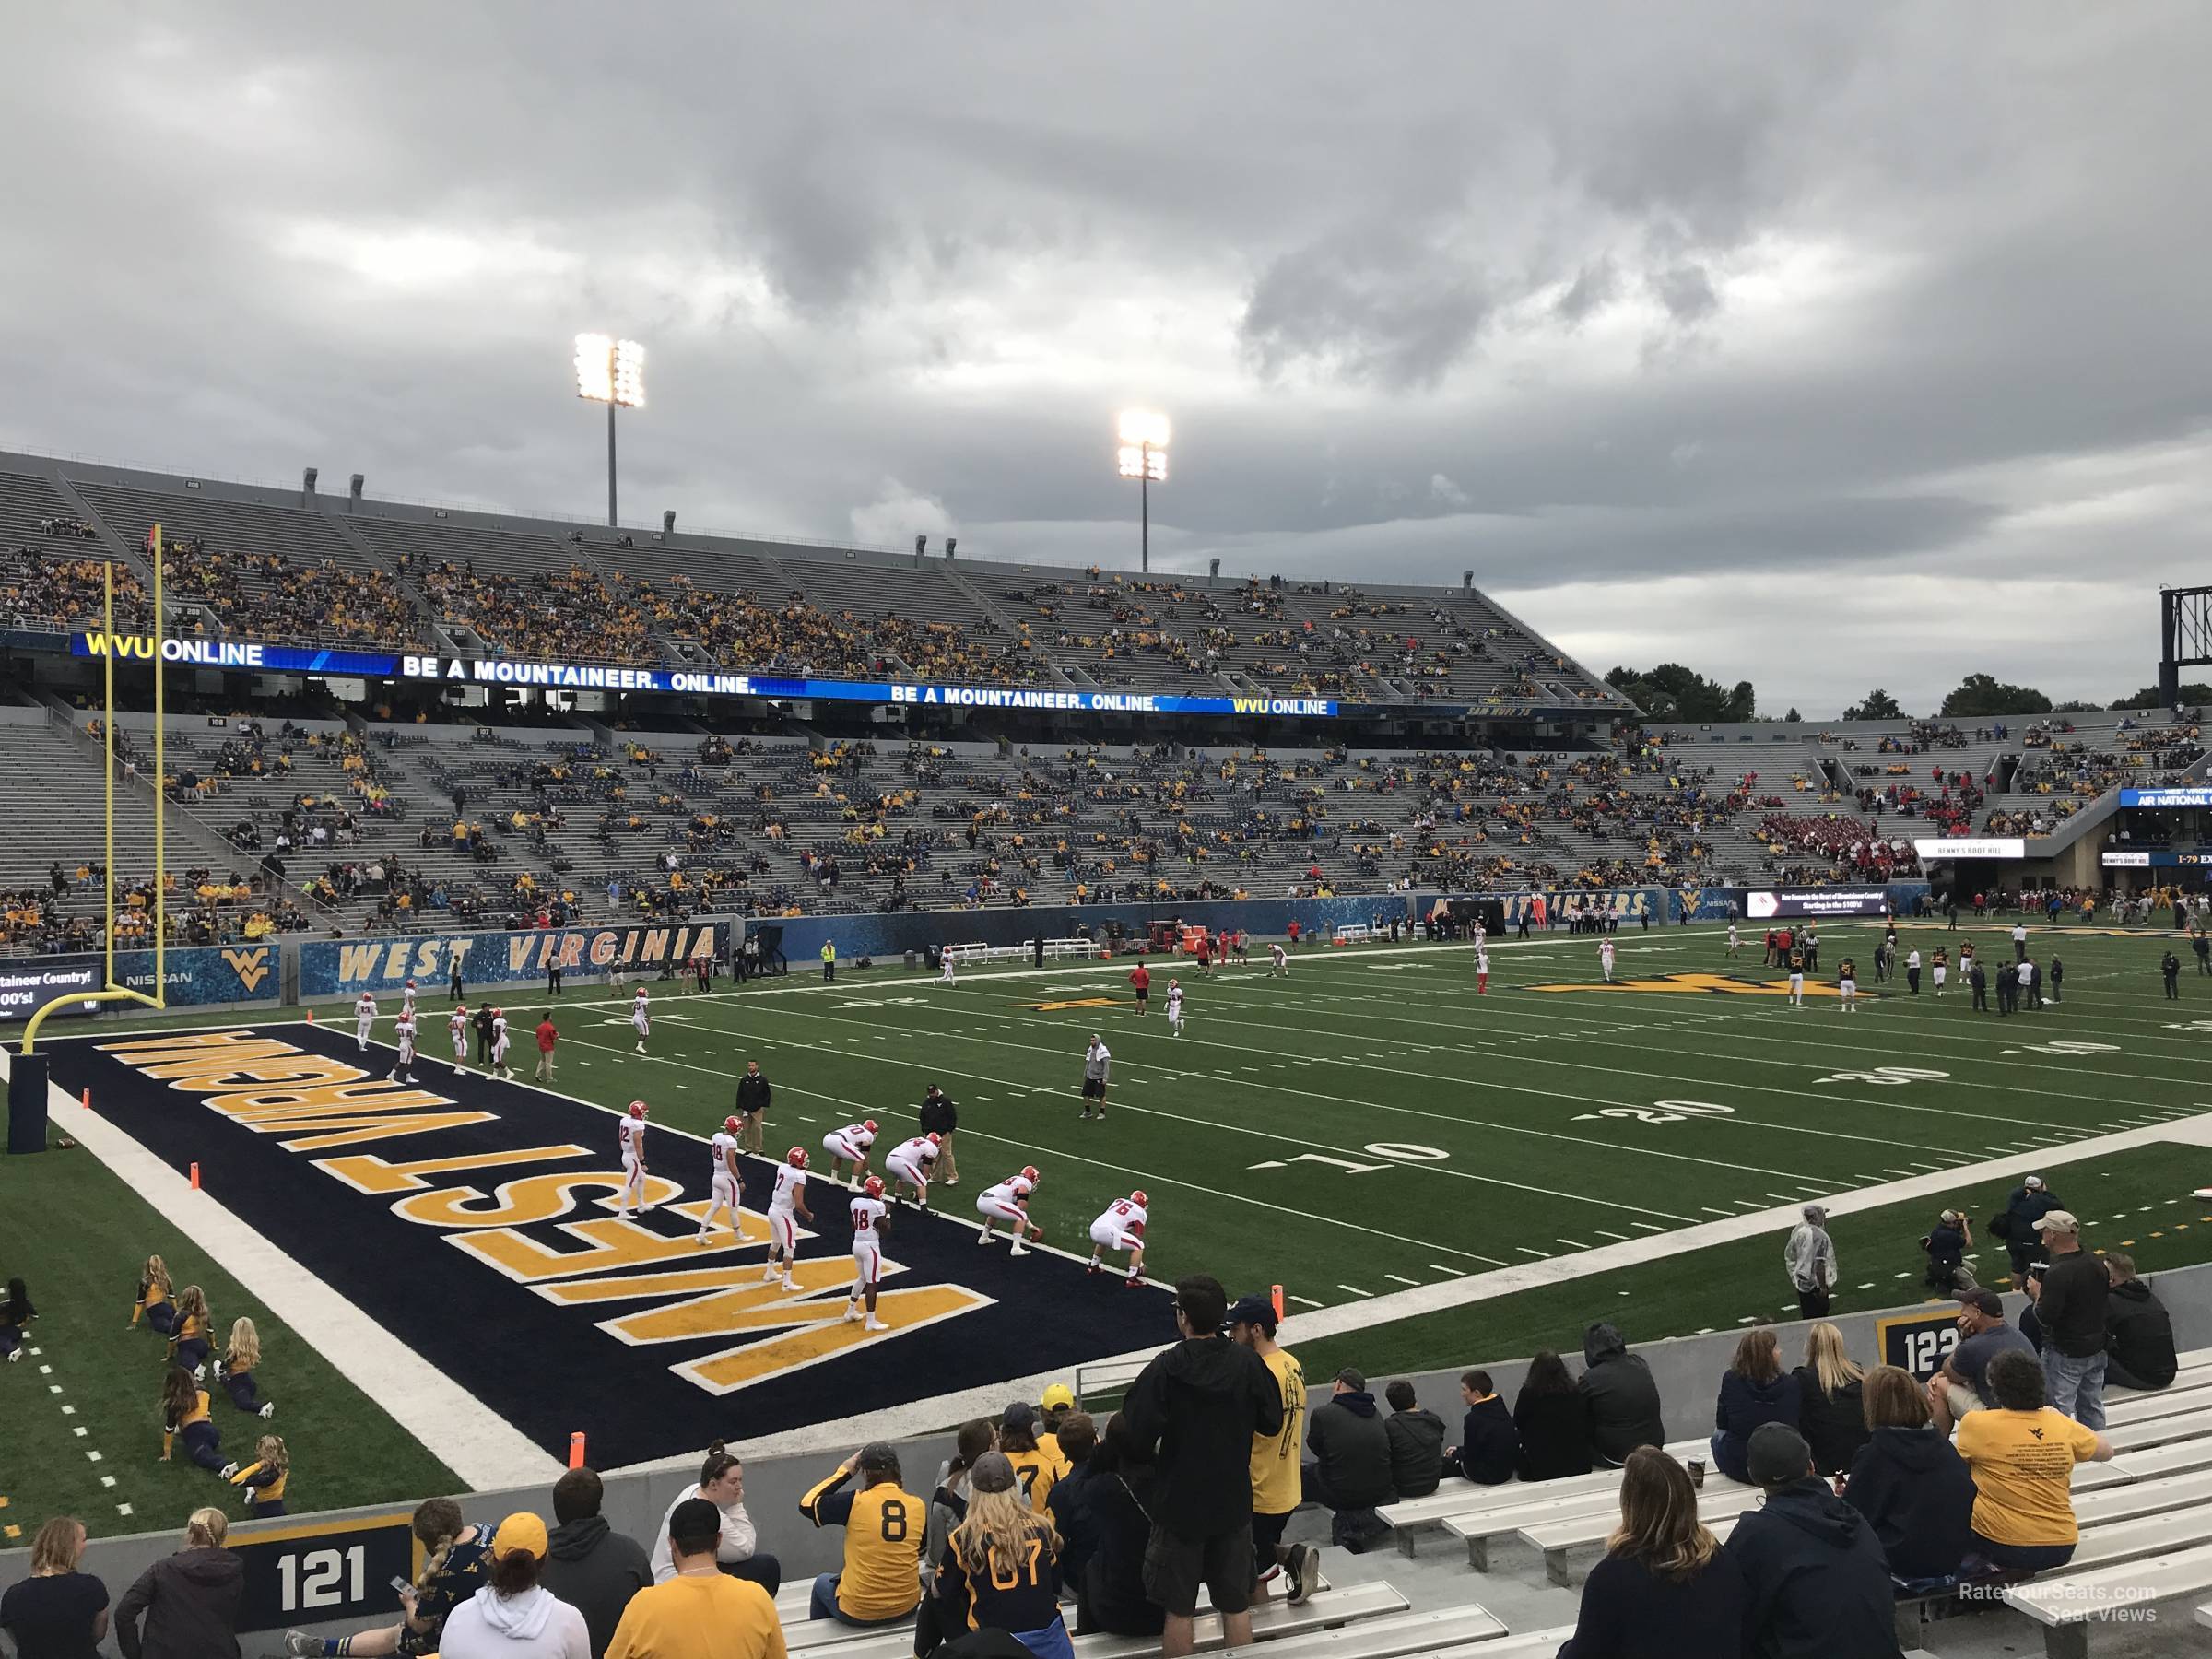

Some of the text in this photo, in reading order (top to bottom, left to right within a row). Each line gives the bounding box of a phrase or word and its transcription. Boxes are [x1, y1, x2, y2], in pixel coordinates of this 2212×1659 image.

[86, 633, 263, 665] WVU ONLINE
[403, 656, 756, 694] BE A MOUNTAINEER. ONLINE.
[891, 686, 1159, 712] BE A MOUNTAINEER. ONLINE.
[1233, 698, 1327, 715] WVU ONLINE
[1467, 707, 1489, 715] SAM
[2137, 795, 2155, 806] AIR
[2157, 794, 2207, 806] NATIONAL
[2178, 855, 2198, 864] I-79
[1803, 901, 1826, 911] Starting
[1832, 900, 1842, 909] the
[338, 926, 715, 982] WEST VIRGINIA
[42, 969, 91, 987] Country!
[1830, 1065, 1952, 1086] 30
[1596, 1099, 1736, 1124] 20
[619, 1124, 630, 1144] 12
[1285, 1141, 1451, 1176] 10
[1114, 1197, 1135, 1217] 76
[853, 1208, 869, 1231] 18
[311, 1143, 998, 1397] WEST
[1904, 1327, 1959, 1374] 122
[881, 1499, 907, 1543] 8
[276, 1545, 365, 1612] 121
